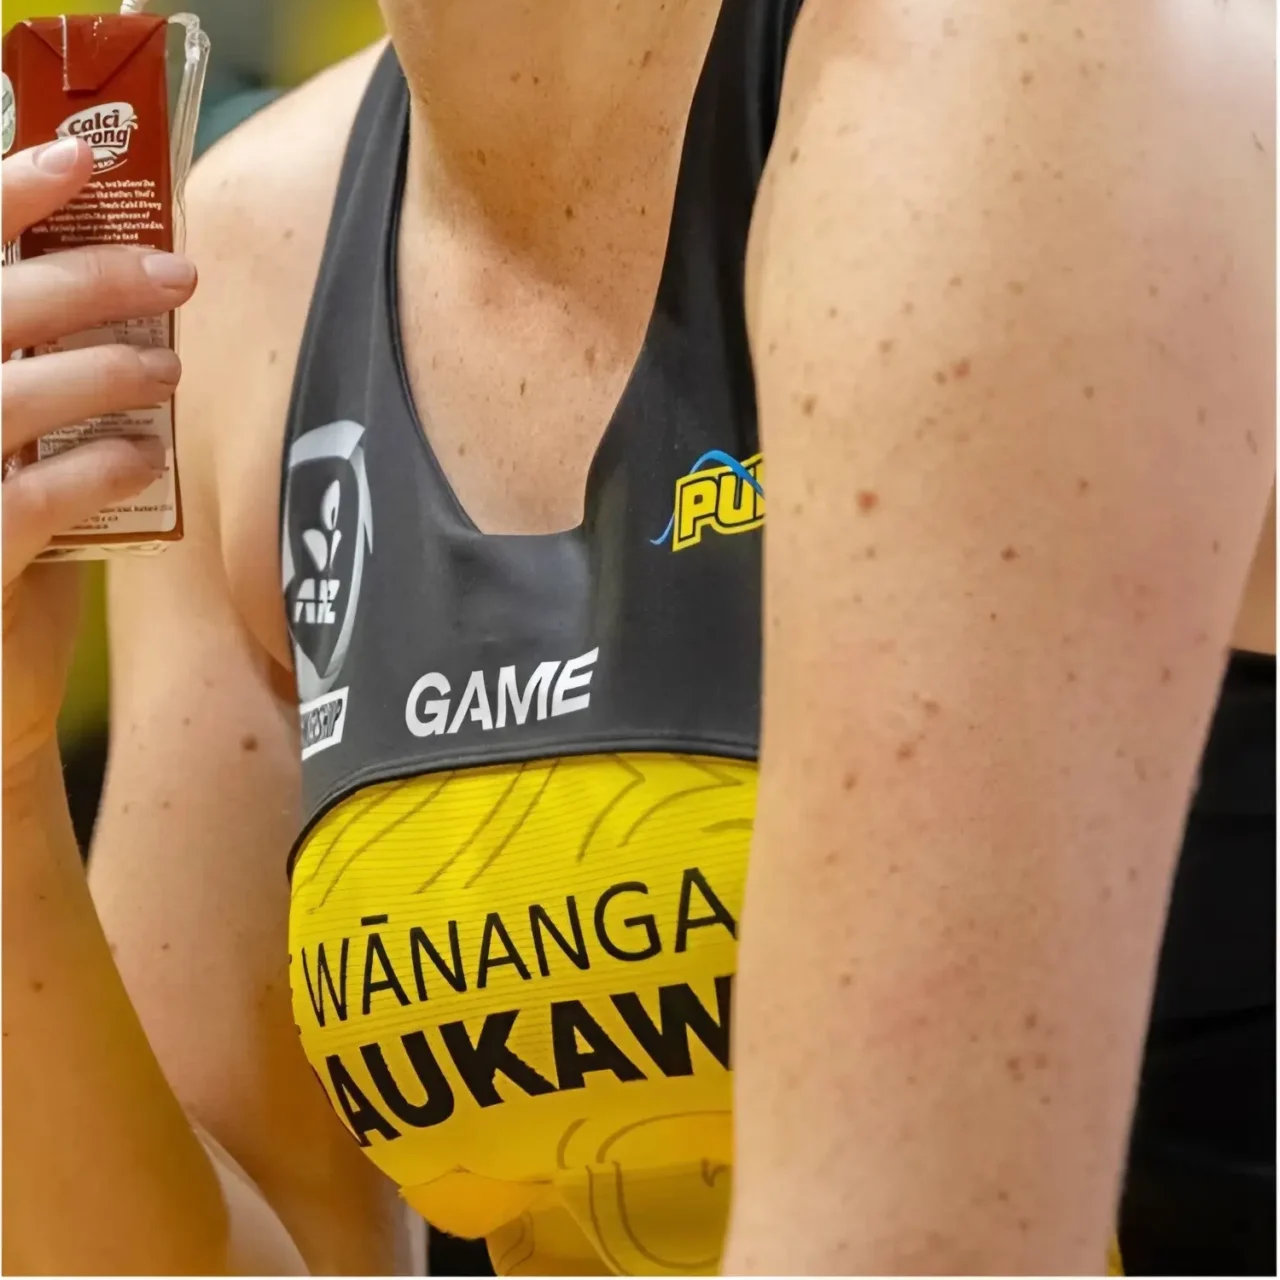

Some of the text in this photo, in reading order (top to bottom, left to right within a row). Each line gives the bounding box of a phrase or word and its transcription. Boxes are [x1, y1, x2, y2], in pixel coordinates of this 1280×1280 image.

[68, 109, 120, 136] Calci
[405, 647, 600, 738] GAME
[301, 867, 739, 1028] WĀNANGA
